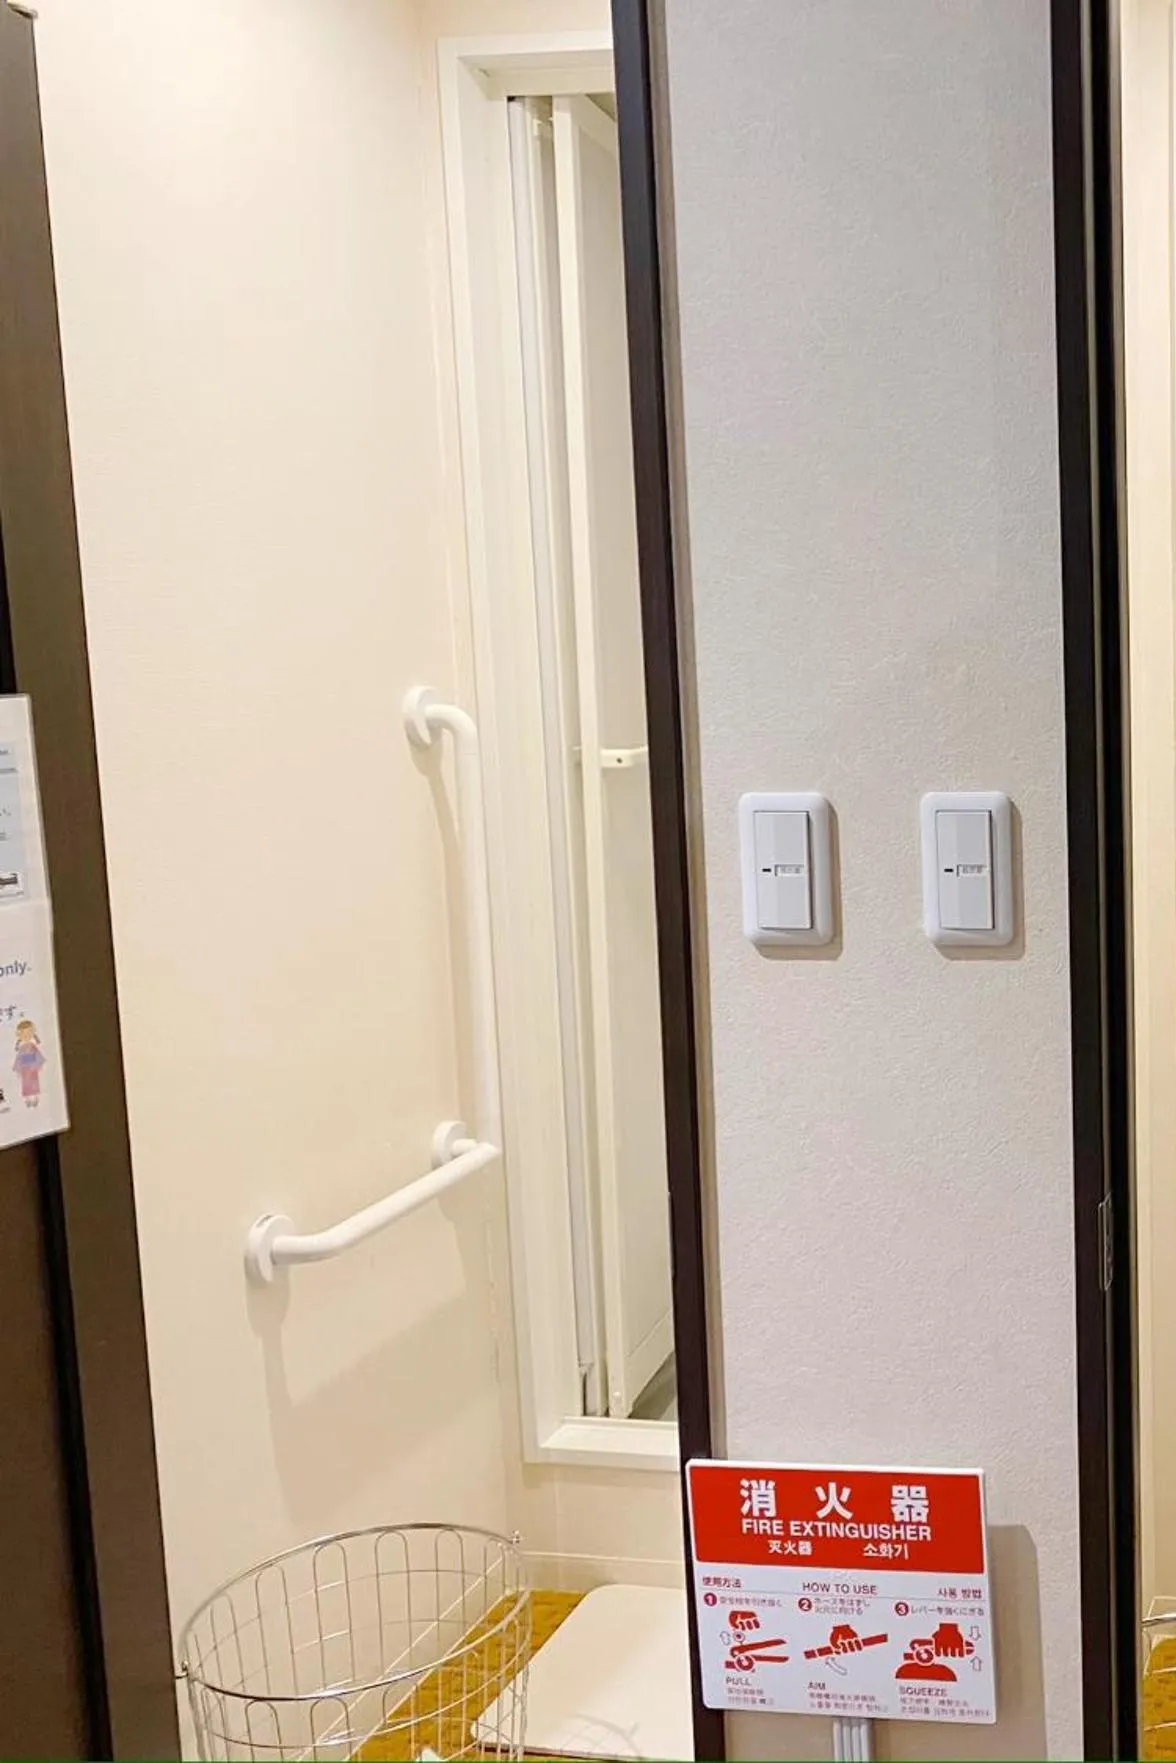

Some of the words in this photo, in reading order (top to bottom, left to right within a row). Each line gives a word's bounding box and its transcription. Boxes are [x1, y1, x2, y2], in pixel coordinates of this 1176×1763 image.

[740, 1479, 929, 1523] 消火器
[742, 1519, 784, 1536] FIRE
[790, 1521, 931, 1541] EXTINGUISHER
[863, 1542, 909, 1559] 소화기
[802, 1582, 831, 1592] HOW
[835, 1583, 850, 1594] TO
[853, 1585, 878, 1595] USE
[725, 1676, 752, 1686] PULL
[899, 1686, 948, 1697] SQUEEZE
